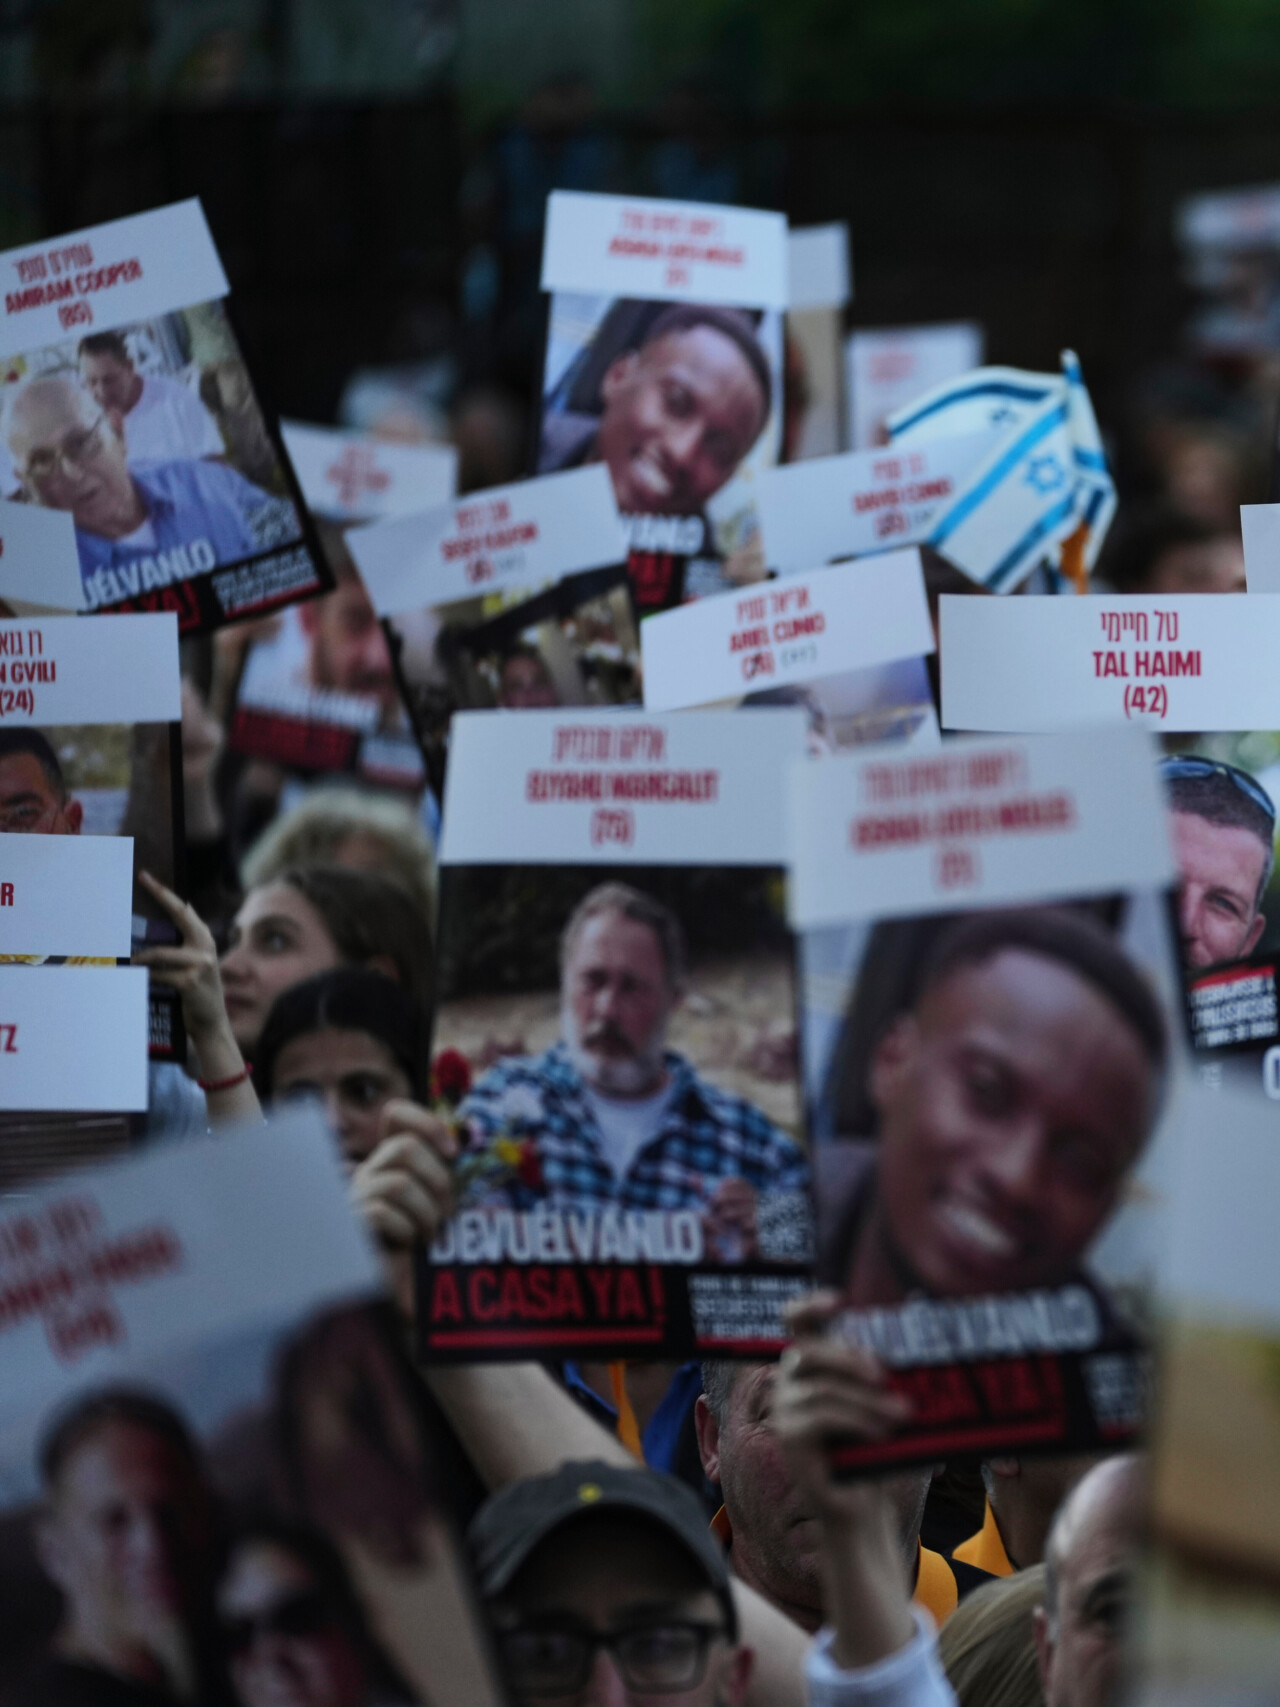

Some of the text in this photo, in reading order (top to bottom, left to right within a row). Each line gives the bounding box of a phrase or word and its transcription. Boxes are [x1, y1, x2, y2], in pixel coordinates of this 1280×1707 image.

[5, 257, 143, 315] AMIRAM COOPER
[1100, 609, 1179, 641] טל חיימי
[11, 660, 56, 683] GVILI
[1093, 651, 1202, 677] TAL HAIMI
[1124, 684, 1168, 720] (42)
[431, 1268, 464, 1322] A
[467, 1266, 586, 1321] CASA
